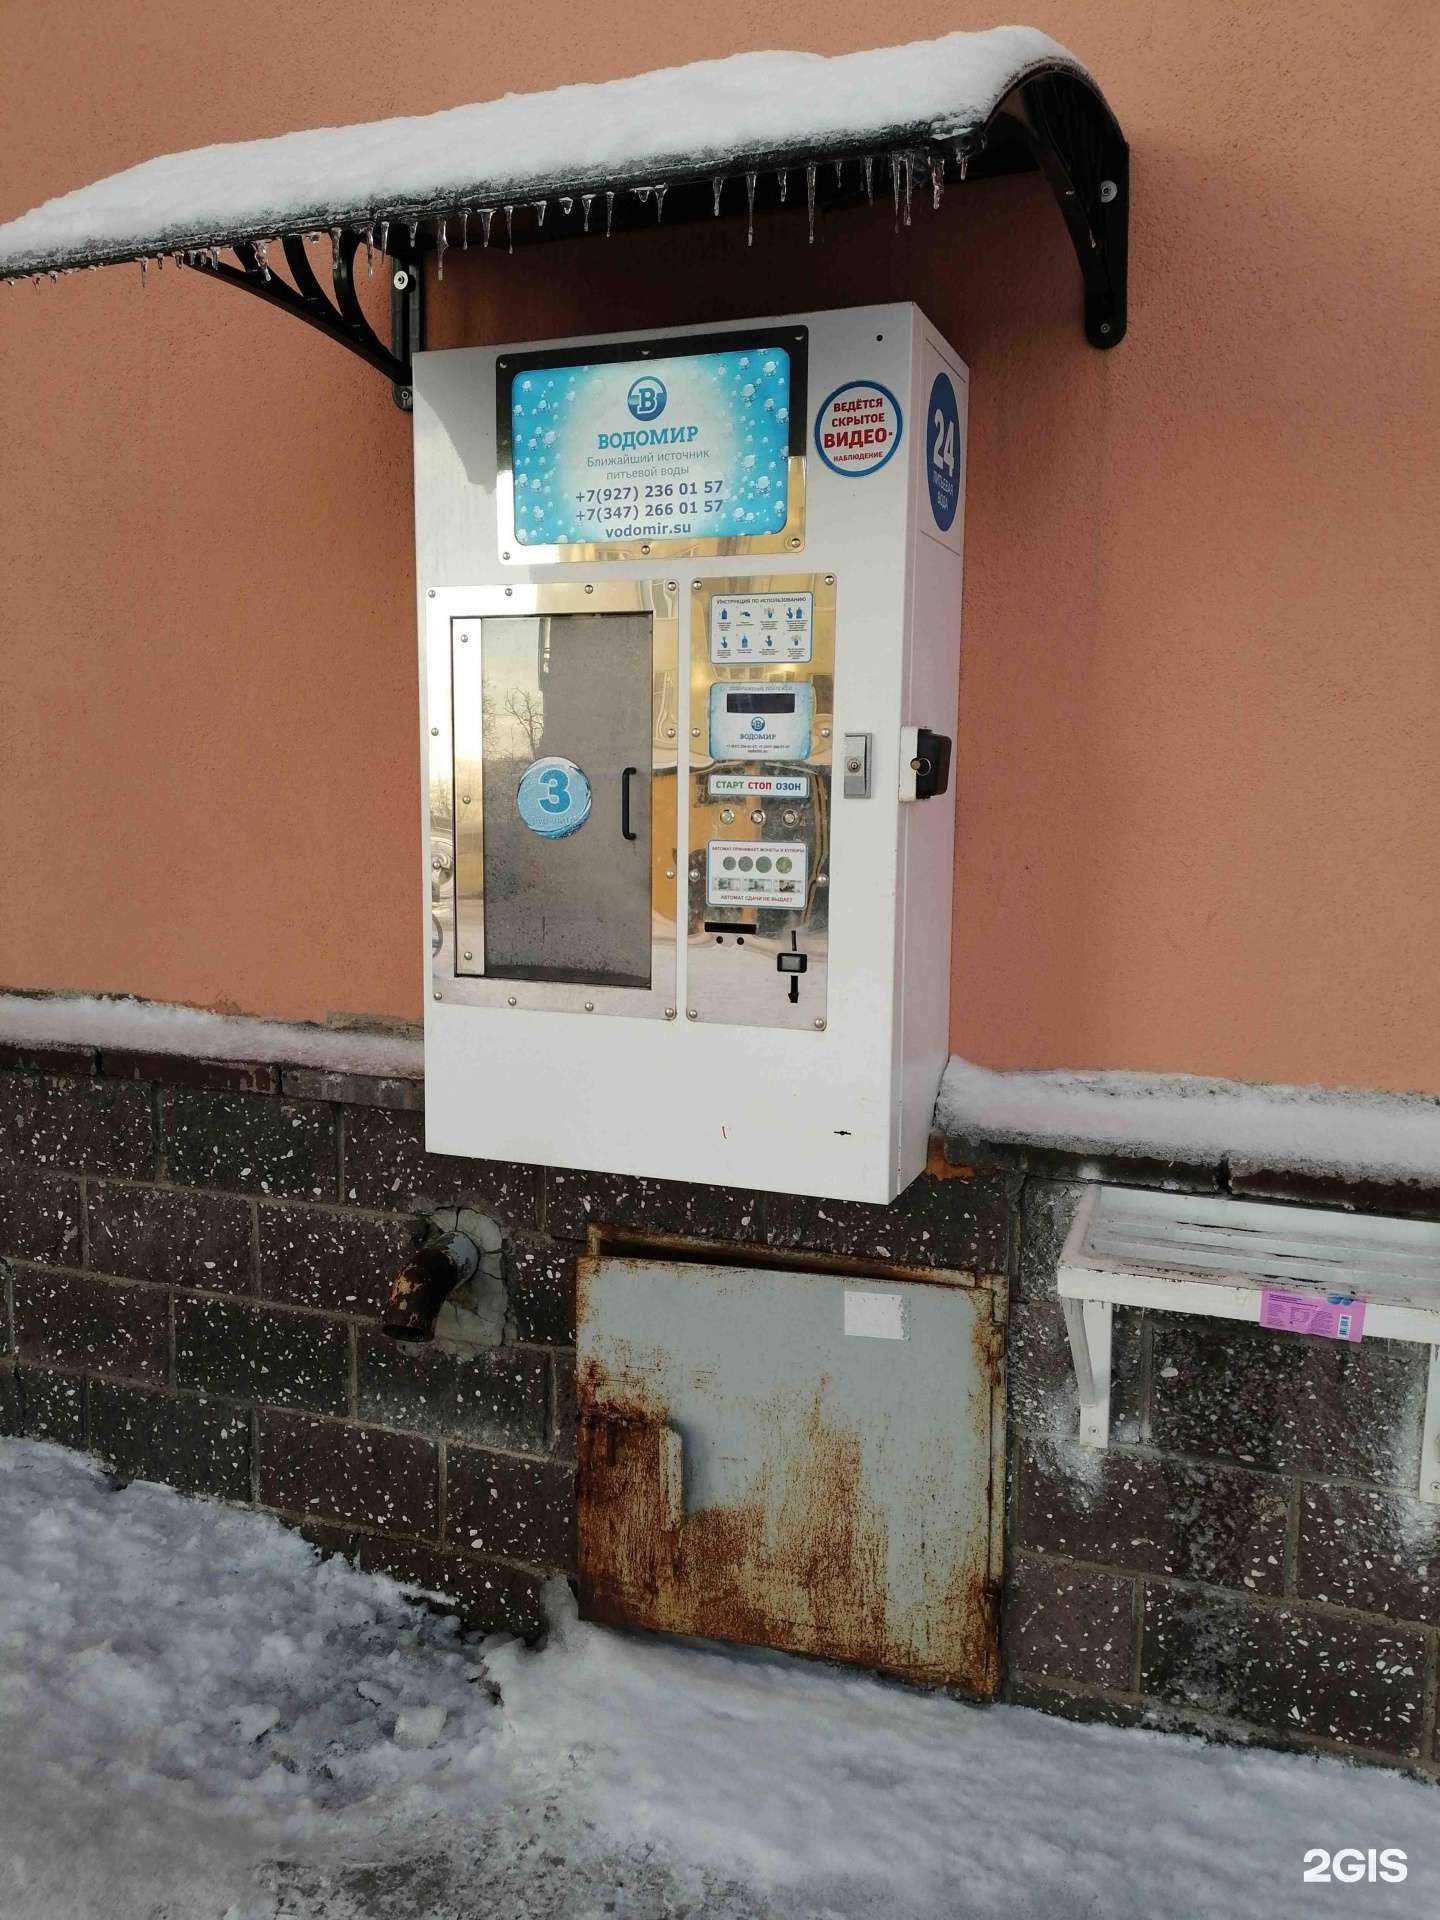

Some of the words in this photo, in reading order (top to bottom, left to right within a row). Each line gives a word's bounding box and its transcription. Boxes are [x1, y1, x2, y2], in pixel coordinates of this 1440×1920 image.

[833, 398, 883, 413] ВЕДЁТСЯ
[831, 413, 885, 428] СКРЫТОЕ
[598, 425, 699, 451] ВОДОМИР
[933, 408, 955, 477] 24
[587, 453, 654, 467] Ближайший
[657, 449, 711, 463] источник
[833, 451, 884, 463] НАБЛЮДЕНИЕ
[606, 466, 658, 480] питьевой
[661, 465, 689, 477] воды
[576, 487, 639, 504] +7(927)
[645, 484, 673, 498] 236
[679, 482, 698, 495] 01
[704, 480, 724, 494] 57
[576, 506, 639, 523] +7(347)
[645, 503, 673, 517] 266
[679, 502, 698, 514] 01
[704, 500, 724, 513] 57
[606, 522, 691, 538] vodomir.su
[538, 768, 572, 814] 3
[715, 781, 745, 789] СТАРТ
[747, 781, 772, 790] СТОП
[775, 782, 801, 791] ОЗОН
